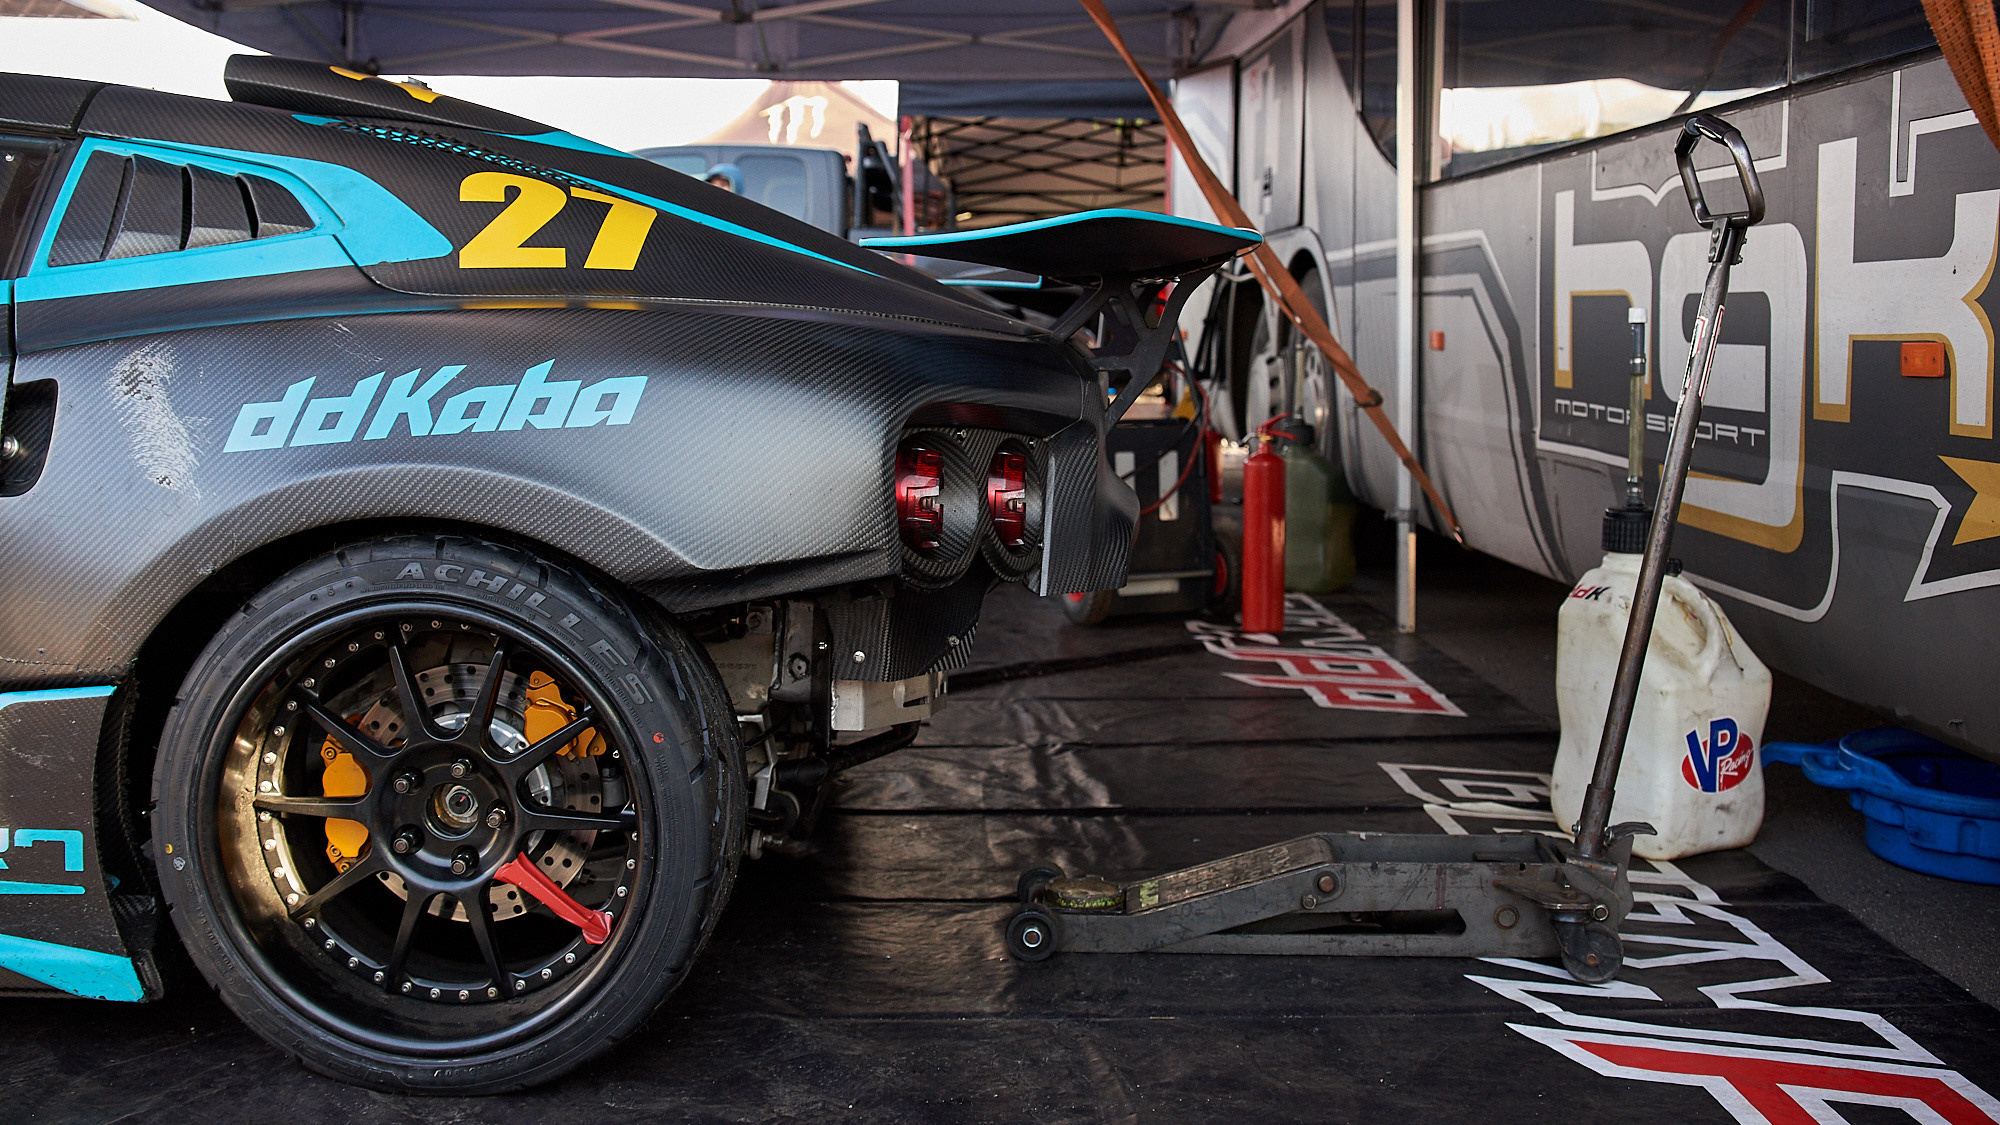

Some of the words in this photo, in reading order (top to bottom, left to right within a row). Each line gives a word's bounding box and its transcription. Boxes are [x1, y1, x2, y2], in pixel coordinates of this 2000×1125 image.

[459, 171, 657, 270] 27
[223, 358, 648, 453] ddKaba
[395, 562, 653, 706] ACHILLES
[1686, 717, 1738, 793] VP
[1720, 748, 1754, 783] Racing
